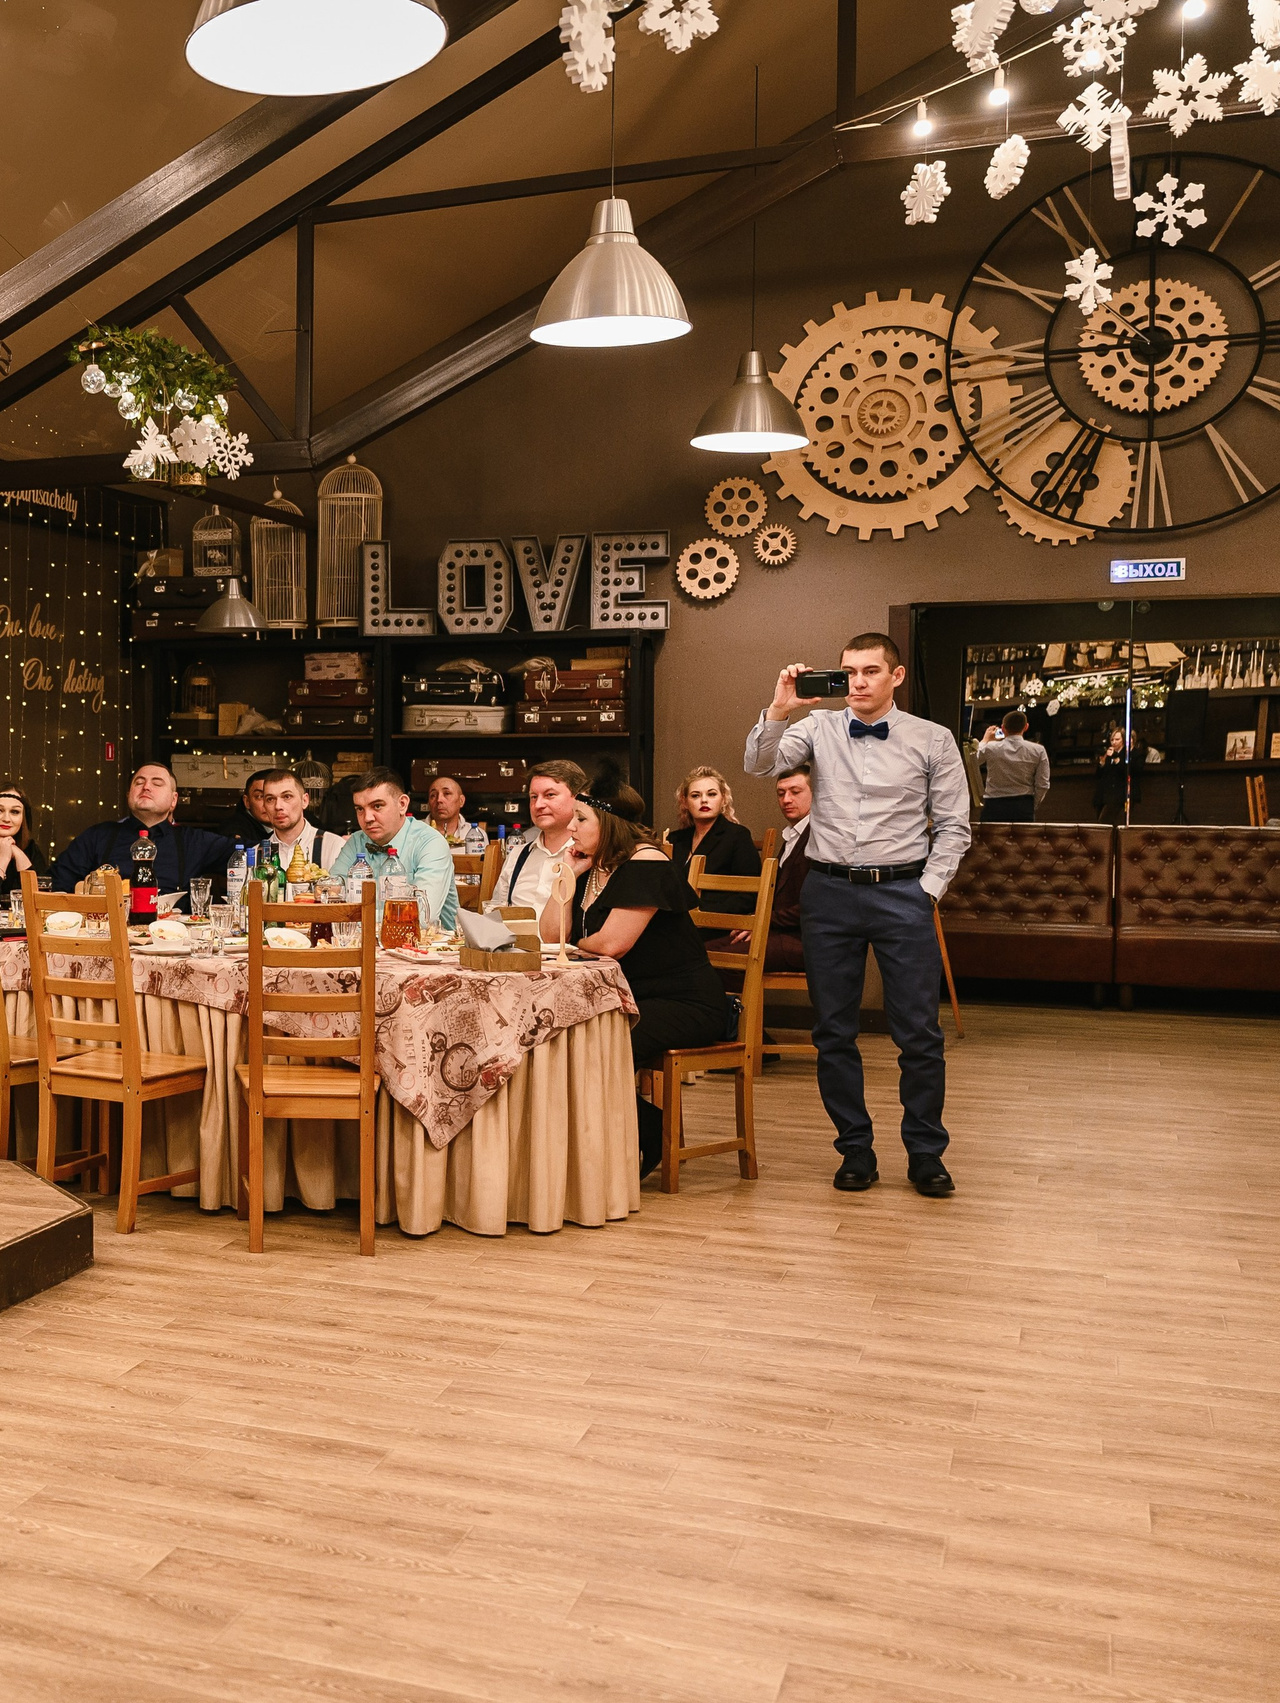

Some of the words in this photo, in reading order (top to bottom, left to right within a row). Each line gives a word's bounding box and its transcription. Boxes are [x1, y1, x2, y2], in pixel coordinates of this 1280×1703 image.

[359, 529, 669, 636] LOVE
[1118, 563, 1178, 578] ВЫХОД
[23, 658, 54, 692] One
